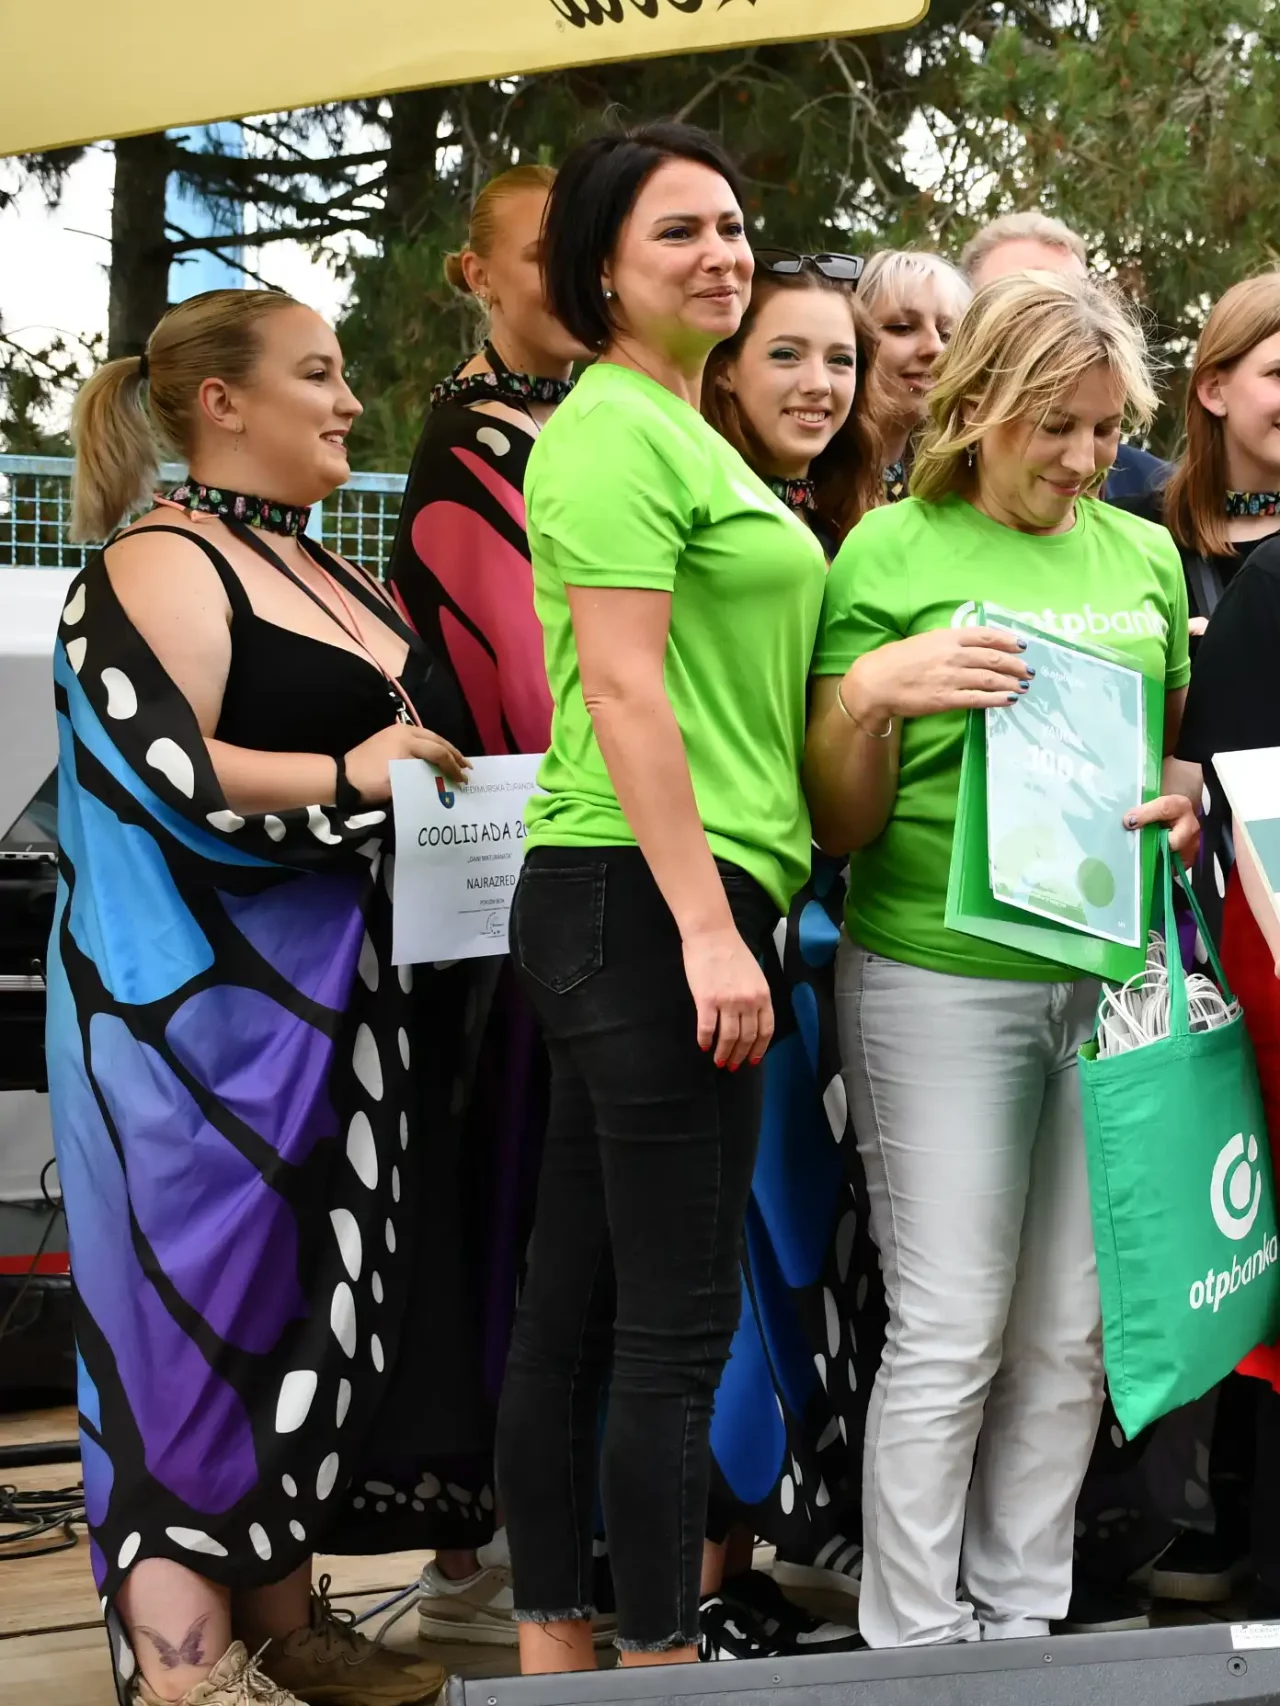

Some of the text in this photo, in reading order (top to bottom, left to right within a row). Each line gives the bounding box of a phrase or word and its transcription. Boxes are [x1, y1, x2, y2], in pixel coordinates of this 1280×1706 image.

[418, 822, 511, 847] COOLIJADA
[467, 874, 516, 889] NAJRAZRED
[1189, 1231, 1278, 1313] otpbanka
